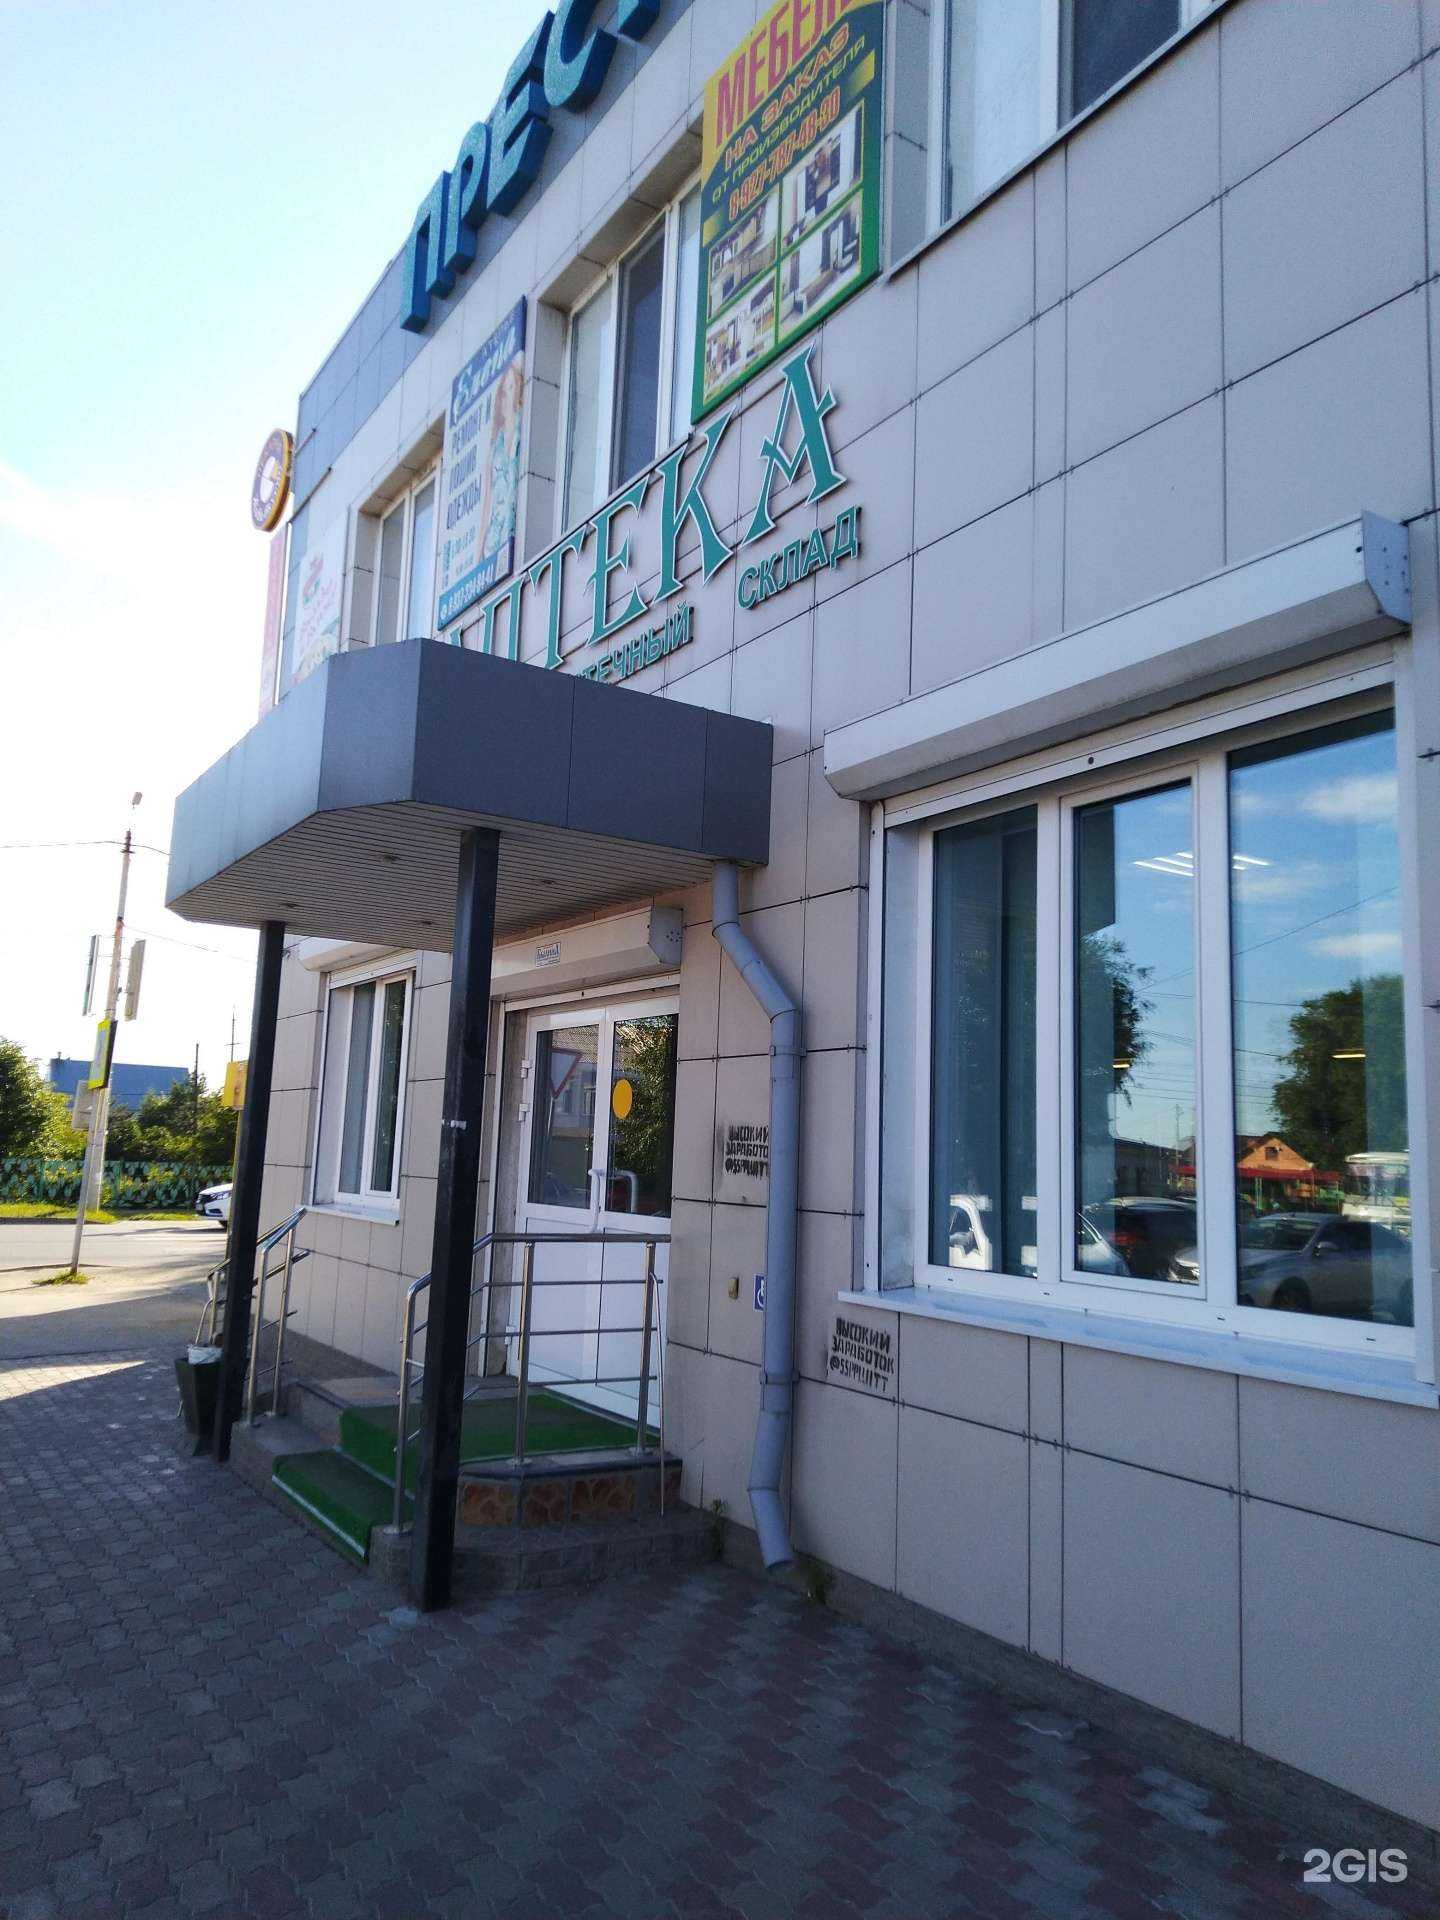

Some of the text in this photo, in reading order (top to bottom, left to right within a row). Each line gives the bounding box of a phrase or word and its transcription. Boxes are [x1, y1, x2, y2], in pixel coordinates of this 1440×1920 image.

[712, 34, 865, 204] ОТ ПРОИЗВОДИТЕЛЯ
[725, 22, 849, 172] НА ЗАКАЗ
[400, 0, 659, 333] ПРЕС
[450, 343, 847, 671] ПТЕКА
[738, 506, 862, 611] СКЛАД
[726, 1141, 769, 1158] ЗАРАБОТО
[832, 1334, 895, 1375] ЗАРАБОТОК
[836, 1316, 891, 1354] ВЫСОКИЙ
